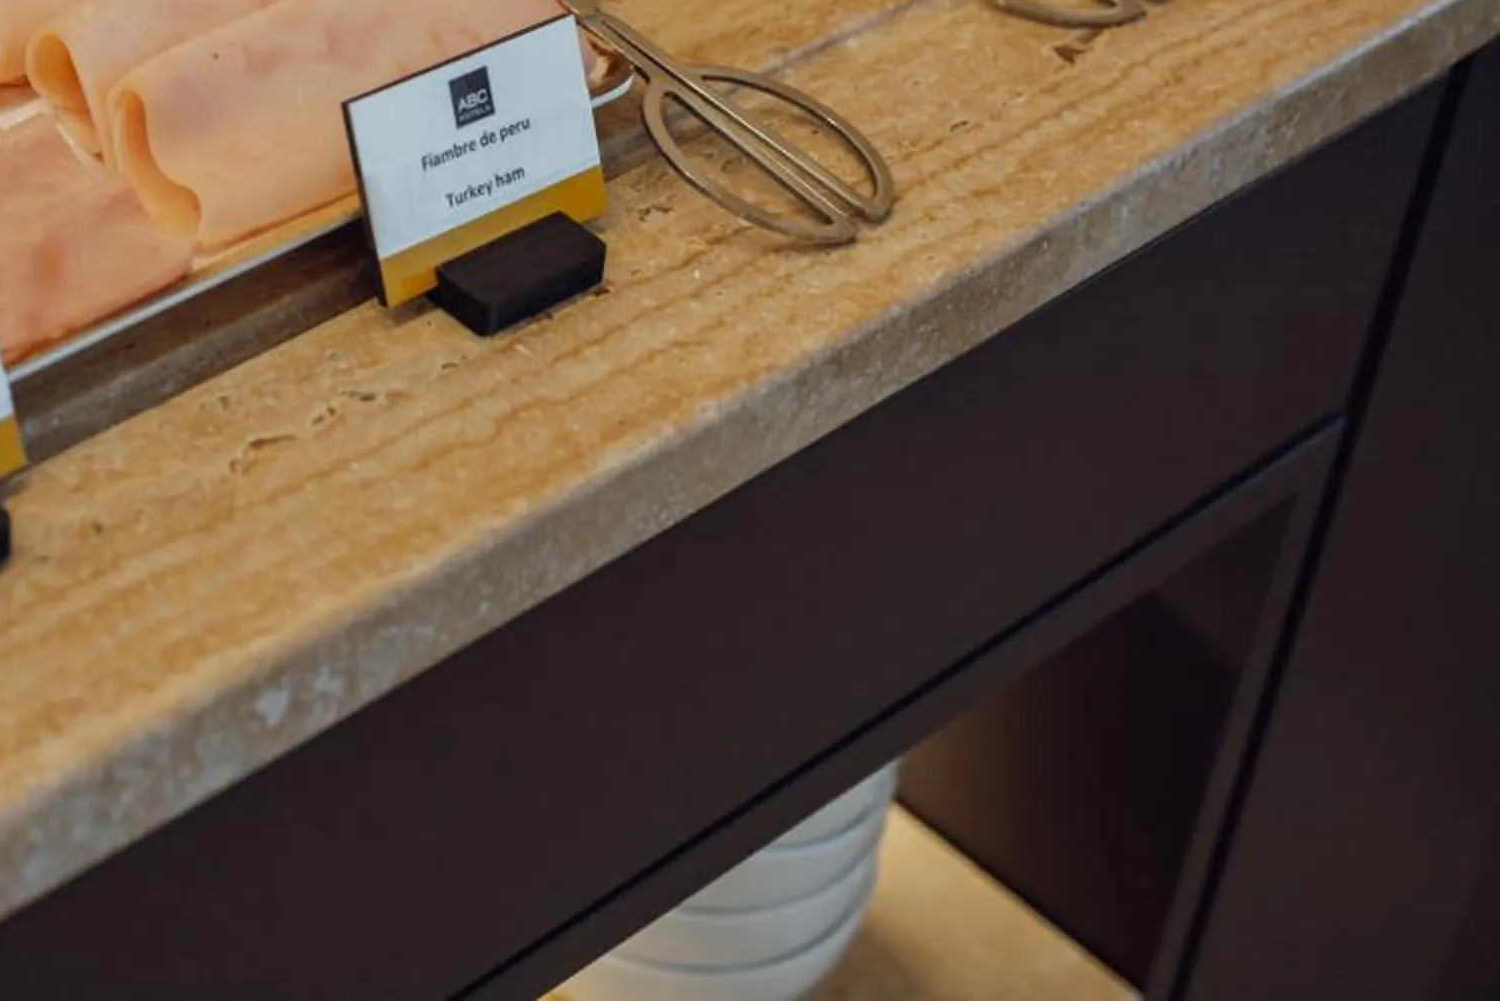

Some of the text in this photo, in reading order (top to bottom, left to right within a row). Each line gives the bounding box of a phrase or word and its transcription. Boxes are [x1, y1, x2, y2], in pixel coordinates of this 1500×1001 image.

[457, 88, 489, 113] ABC
[420, 118, 531, 172] Fiambre de peru
[445, 166, 525, 207] Turkey ham
